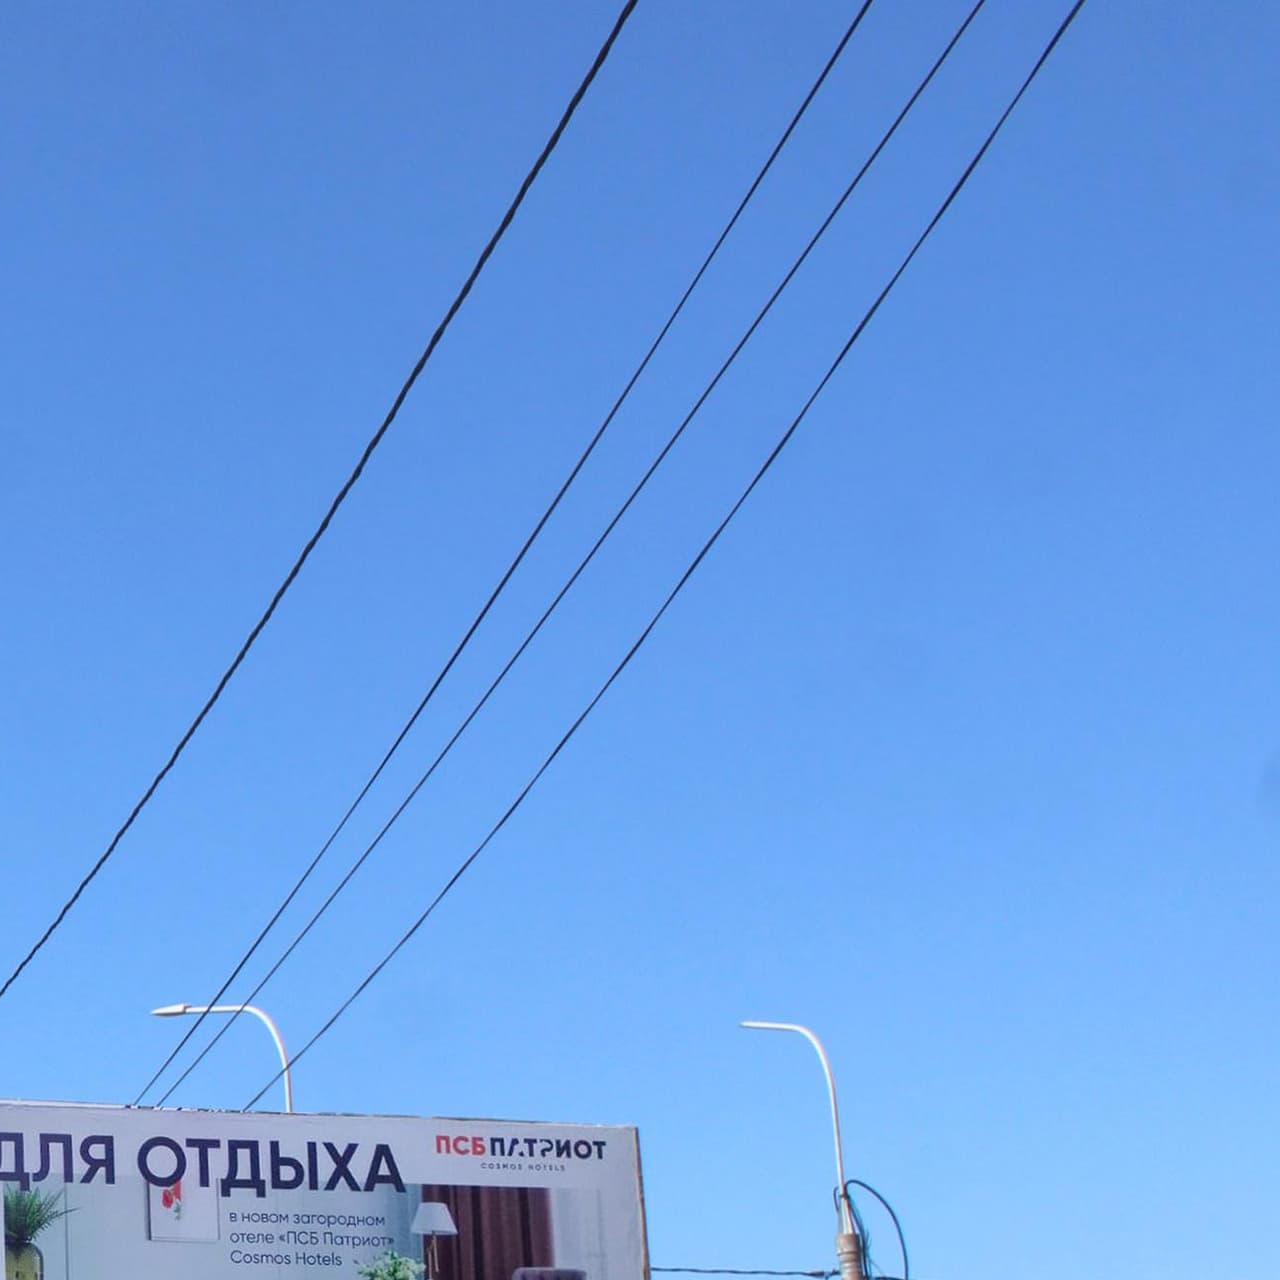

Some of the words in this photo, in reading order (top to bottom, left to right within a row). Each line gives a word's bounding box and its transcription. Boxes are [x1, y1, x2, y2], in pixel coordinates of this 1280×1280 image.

[137, 1135, 407, 1198] ОТДЫХА
[480, 1162, 523, 1171] COSMOS
[229, 1212, 238, 1223] в
[241, 1212, 289, 1224] новом
[293, 1213, 386, 1228] загородном
[229, 1231, 275, 1244] отеле
[278, 1230, 319, 1246] «ПСБ
[323, 1231, 395, 1249] Патриот»
[230, 1250, 291, 1265] Cosmos
[295, 1251, 343, 1266] Hotels
